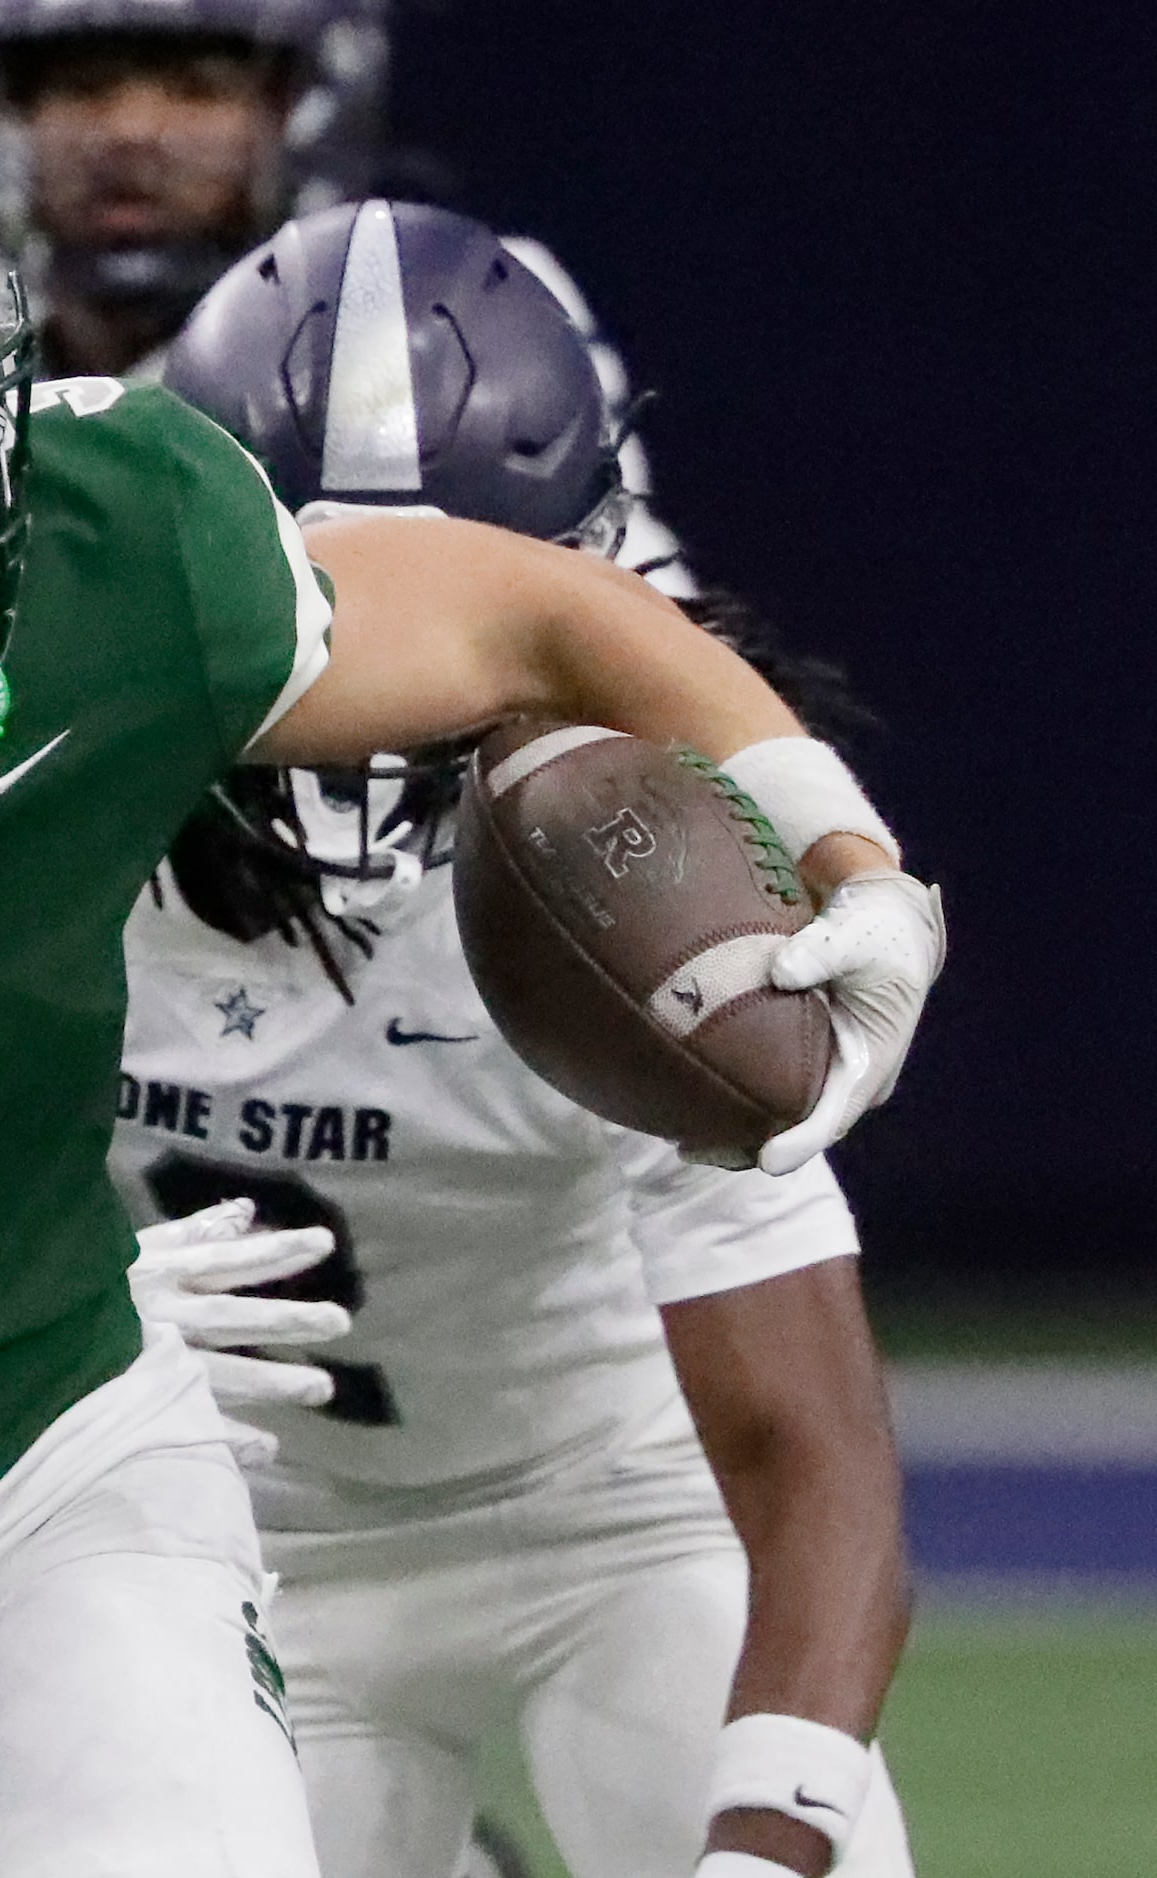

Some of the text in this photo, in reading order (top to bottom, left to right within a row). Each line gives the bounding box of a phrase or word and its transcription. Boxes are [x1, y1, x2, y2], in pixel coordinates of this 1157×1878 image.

[582, 807, 657, 879] R
[116, 1072, 392, 1162] ONE STAR
